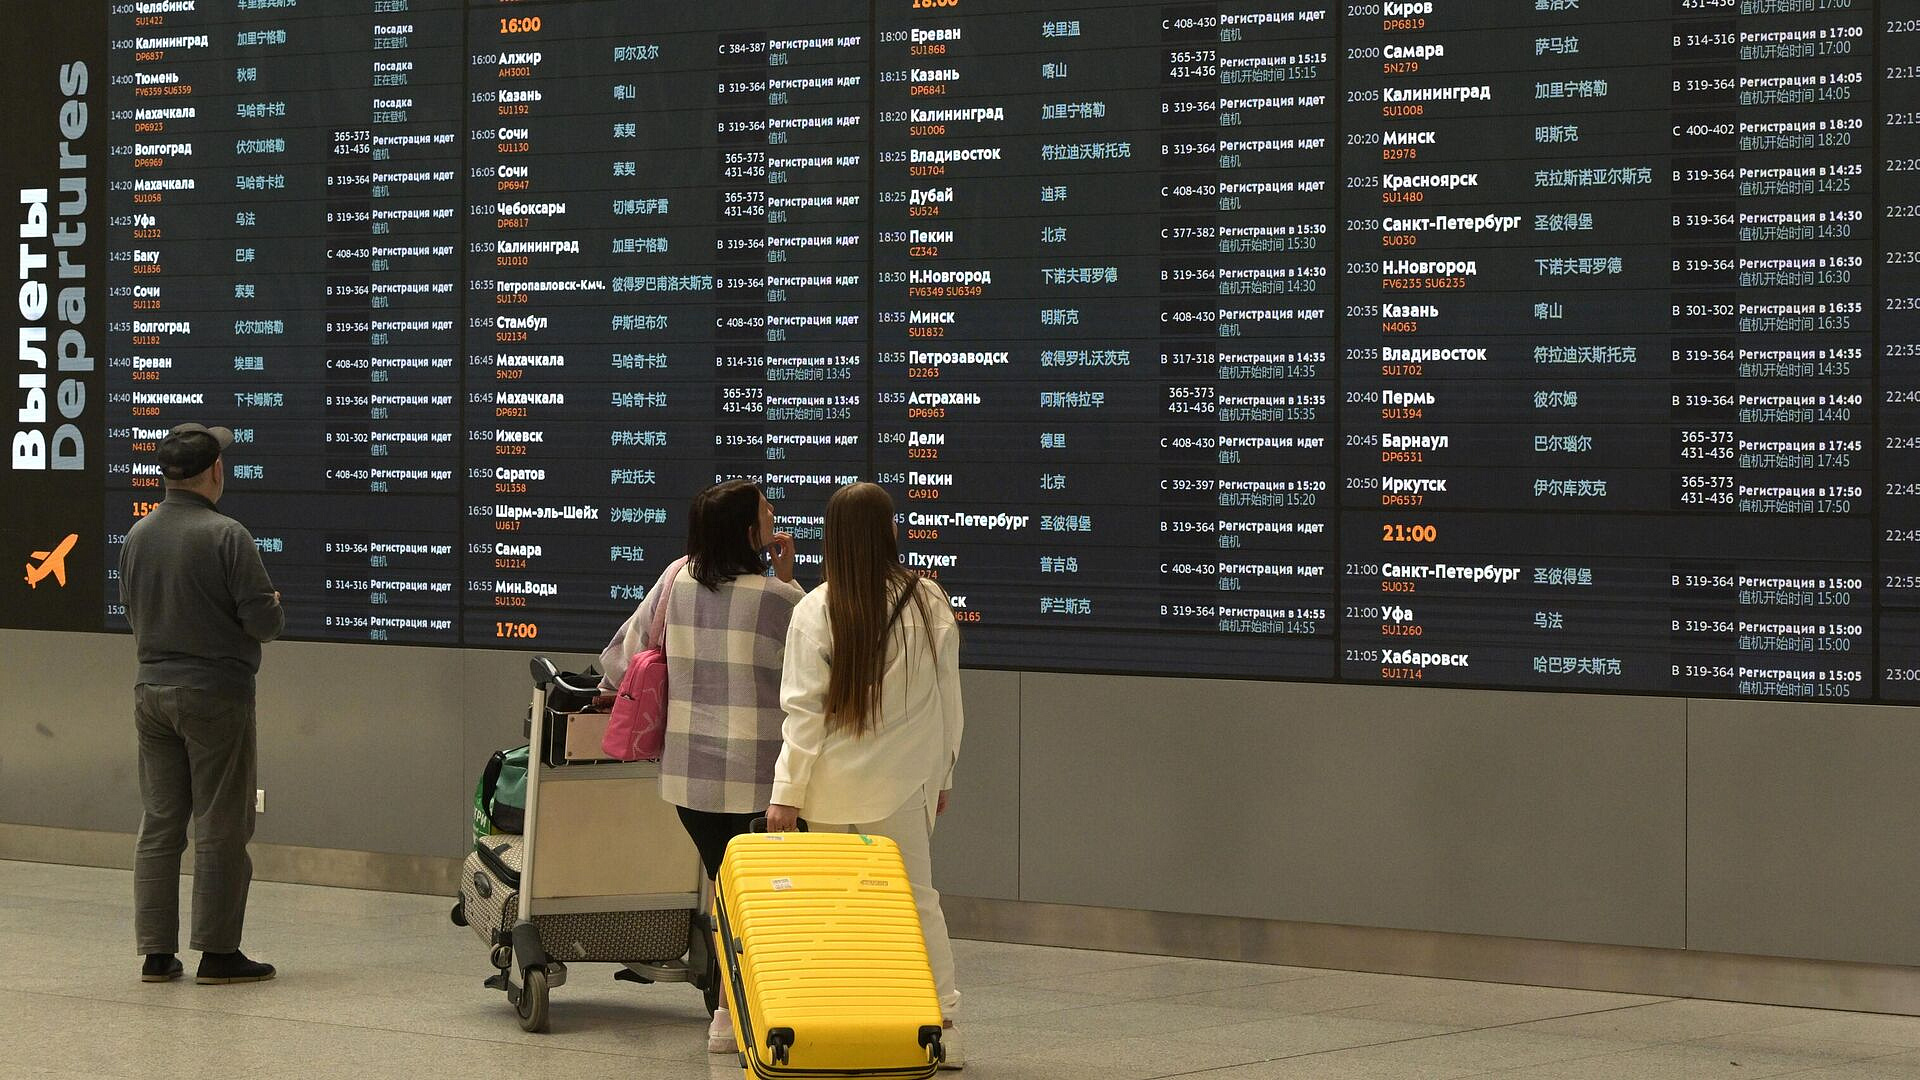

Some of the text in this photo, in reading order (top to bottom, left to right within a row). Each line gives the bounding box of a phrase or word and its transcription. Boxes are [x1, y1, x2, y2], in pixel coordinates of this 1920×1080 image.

[136, 0, 195, 14] Челябинск
[1348, 1, 1433, 18] 20:00 Киров
[500, 16, 541, 33] 16:00
[1384, 18, 1425, 30] DP6819
[136, 35, 208, 49] Калининград
[769, 36, 861, 50] Регистрация идет
[880, 28, 961, 44] 18:00 Ереван
[1740, 30, 1816, 45] Регистрация
[1830, 27, 1863, 38] 17:00
[1348, 45, 1444, 60] 20:00 Самара
[1535, 36, 1579, 56] 萨马拉
[472, 52, 541, 66] 16:00 Алжир
[1171, 50, 1215, 63] 365-373
[374, 62, 413, 72] Посадка
[1170, 65, 1216, 77] 431-436
[1383, 61, 1420, 74] 5N279
[135, 73, 179, 85] Тюмень
[880, 69, 960, 82] 18:15 Казань
[1740, 76, 1816, 91] Регистрация
[1830, 72, 1862, 84] 14:05
[614, 84, 636, 100] 喀山
[1347, 86, 1491, 102] 20:05 Калининград
[1535, 79, 1607, 99] 加里宁格勒
[472, 90, 542, 103] 16:05 Казань
[1220, 96, 1325, 110] Регистрация идет
[135, 107, 195, 120] Махачкала
[880, 107, 1004, 122] 18:20 Калининград
[1383, 105, 1424, 116] SU1008
[373, 134, 455, 146] Регистрация идет
[472, 127, 528, 140] 16:05 Сочи
[1347, 131, 1436, 145] 20:20 Минск
[1535, 125, 1579, 143] 明斯克
[135, 143, 192, 157] Волгоград
[910, 148, 1001, 164] Владивосток
[1383, 148, 1416, 160] B2978
[498, 165, 528, 178] Сочи
[134, 179, 195, 191] Махачкала
[1347, 174, 1478, 191] 20:25 Красноярск
[879, 187, 953, 205] 18:25 Дубай
[1383, 192, 1424, 203] SU1480
[471, 201, 565, 217] 16:10 Чебоксары
[133, 213, 155, 229] Уфа
[1347, 214, 1521, 232] 20:30 Санкт-Петербург
[1534, 213, 1593, 231] 圣彼得堡
[879, 230, 953, 243] 18:30 Пекин
[1041, 226, 1067, 243] 北京
[1383, 235, 1416, 246] SU030
[497, 240, 579, 255] Калининград
[134, 250, 160, 265] Баку
[51, 60, 95, 470] Departures
[1347, 260, 1476, 277] 20:30 Н.Новгород
[470, 280, 494, 290] 16:35
[879, 270, 991, 288] 18:30 Н.Новгород
[1382, 276, 1466, 289] FV6235 SU6235
[133, 285, 160, 297] Сочи
[909, 310, 955, 324] Минск
[1347, 304, 1439, 318] 20:35 Казань
[12, 188, 48, 470] Вылеты
[133, 321, 190, 335] Волгоград
[496, 315, 547, 331] Стамбул
[1382, 321, 1417, 332] N4063
[470, 354, 564, 366] 16:45 Махачкала
[611, 353, 667, 369] 马哈奇卡拉
[909, 350, 1009, 367] Петрозаводск
[1346, 347, 1487, 363] 20:35 Владивосток
[133, 356, 172, 371] Ереван
[1382, 364, 1423, 376] SU1702
[133, 392, 203, 404] Нижнекамск
[496, 392, 564, 404] Махачкала
[878, 391, 981, 407] 18:35 Астрахань
[1169, 387, 1214, 398] 365-373
[1346, 390, 1435, 407] 20:40 Пермь
[1168, 402, 1214, 413] 431-436
[1382, 407, 1422, 419] SU1394
[132, 427, 169, 439] Тюмен
[469, 429, 543, 442] 16:50 Ижевск
[908, 431, 944, 447] Дели
[1682, 431, 1734, 443] 365-373
[1346, 433, 1448, 451] 20:45 Барнаул
[1381, 450, 1423, 462] DP6531
[1681, 447, 1734, 459] 431-436
[132, 463, 163, 475] Минс
[496, 467, 545, 482] Саратов
[909, 472, 952, 485] Пекин
[1040, 473, 1066, 490] 北京
[1346, 476, 1447, 494] 20:50 Иркутск
[1682, 476, 1733, 488] 365-373
[1382, 495, 1423, 505] DP6537
[1681, 492, 1734, 504] 431-436
[496, 505, 599, 520] Шарм-эль-Шейх
[908, 512, 1029, 530] Санкт-Петербург
[1383, 524, 1437, 542] 21:00
[468, 543, 542, 559] 16:55 Самара
[909, 552, 957, 569] Пхукет
[1346, 563, 1520, 584] 21:00 Санкт-Петербург
[495, 580, 557, 596] Мин.Воды
[1382, 581, 1415, 592] SU032
[1346, 605, 1413, 624] 21:00 Уфа
[1533, 611, 1563, 629] 乌法
[496, 622, 538, 638] 17:00
[1382, 624, 1423, 636] SU1260
[1346, 649, 1469, 668] 21:05 Хабаровск
[1534, 656, 1621, 675] 哈巴罗夫斯克
[1381, 667, 1422, 680] SU1714
